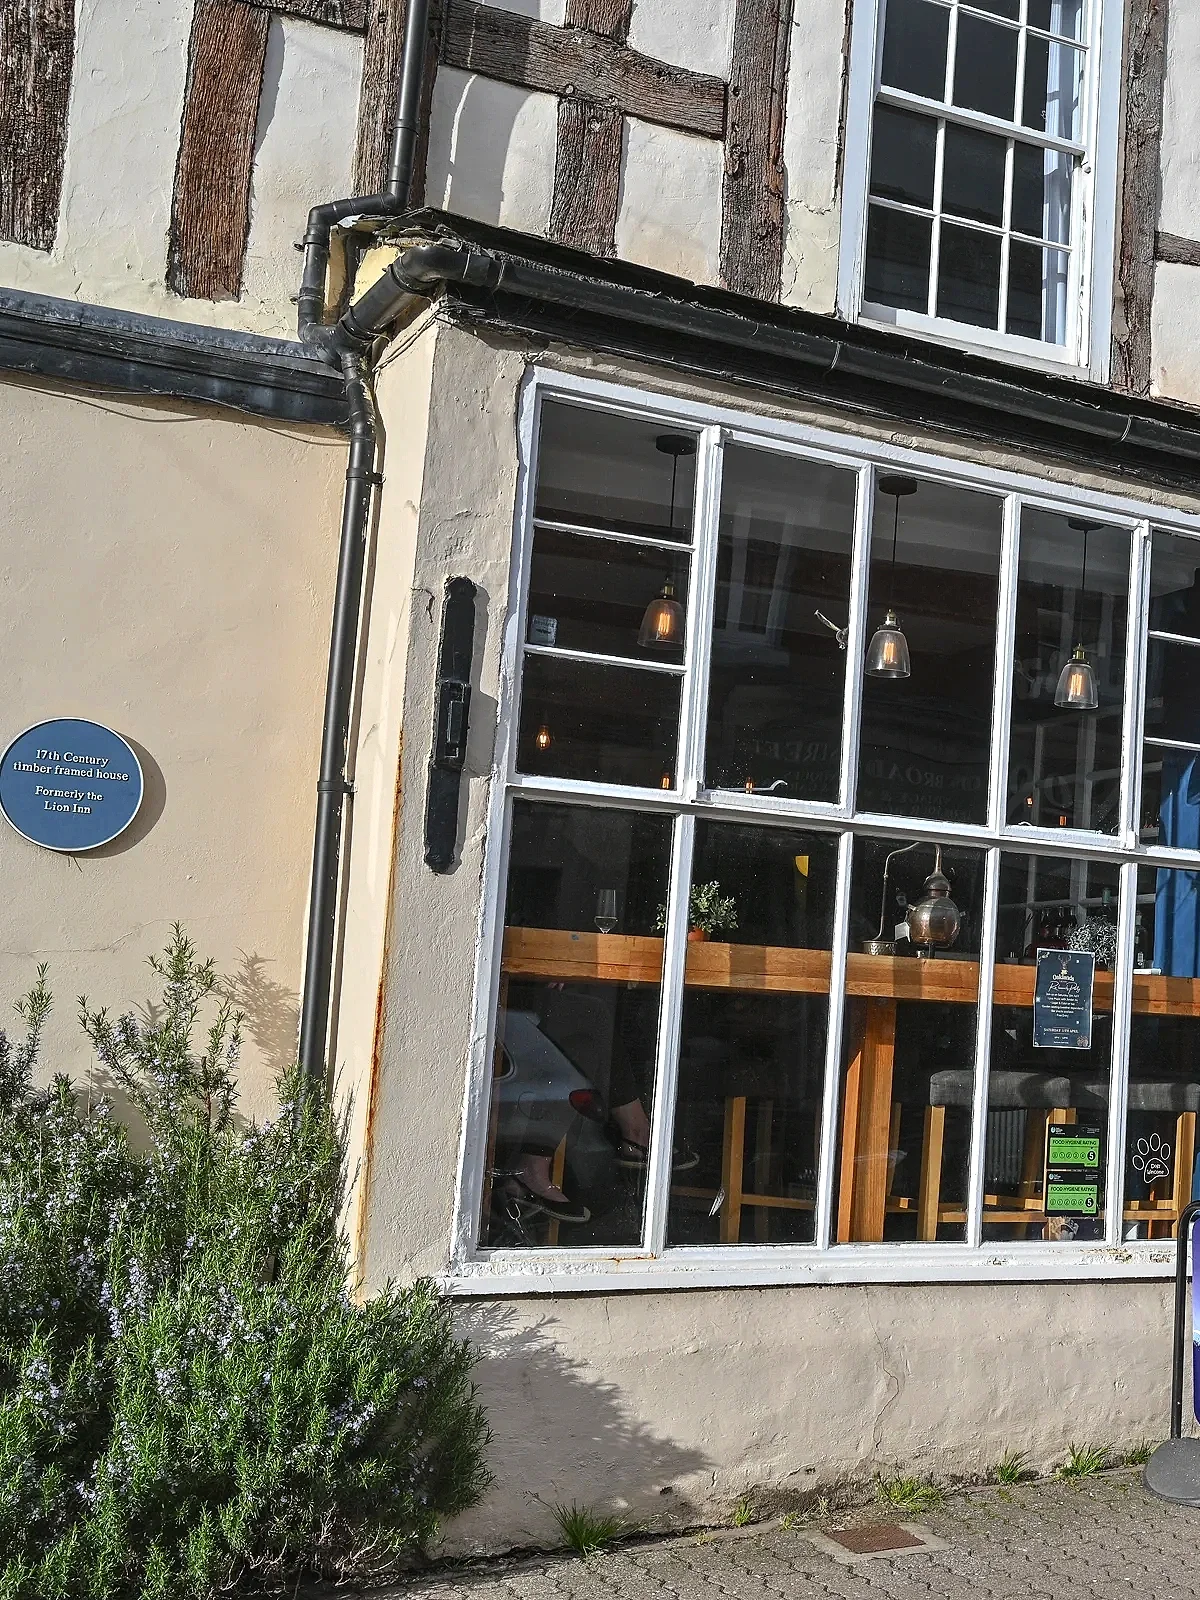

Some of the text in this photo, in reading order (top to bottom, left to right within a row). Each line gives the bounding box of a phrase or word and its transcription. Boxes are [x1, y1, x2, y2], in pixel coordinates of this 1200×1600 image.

[36, 750, 108, 767] 17th Century
[13, 762, 128, 780] timber framed house
[35, 786, 102, 800] Formerly the
[44, 801, 91, 813] Lion Inn
